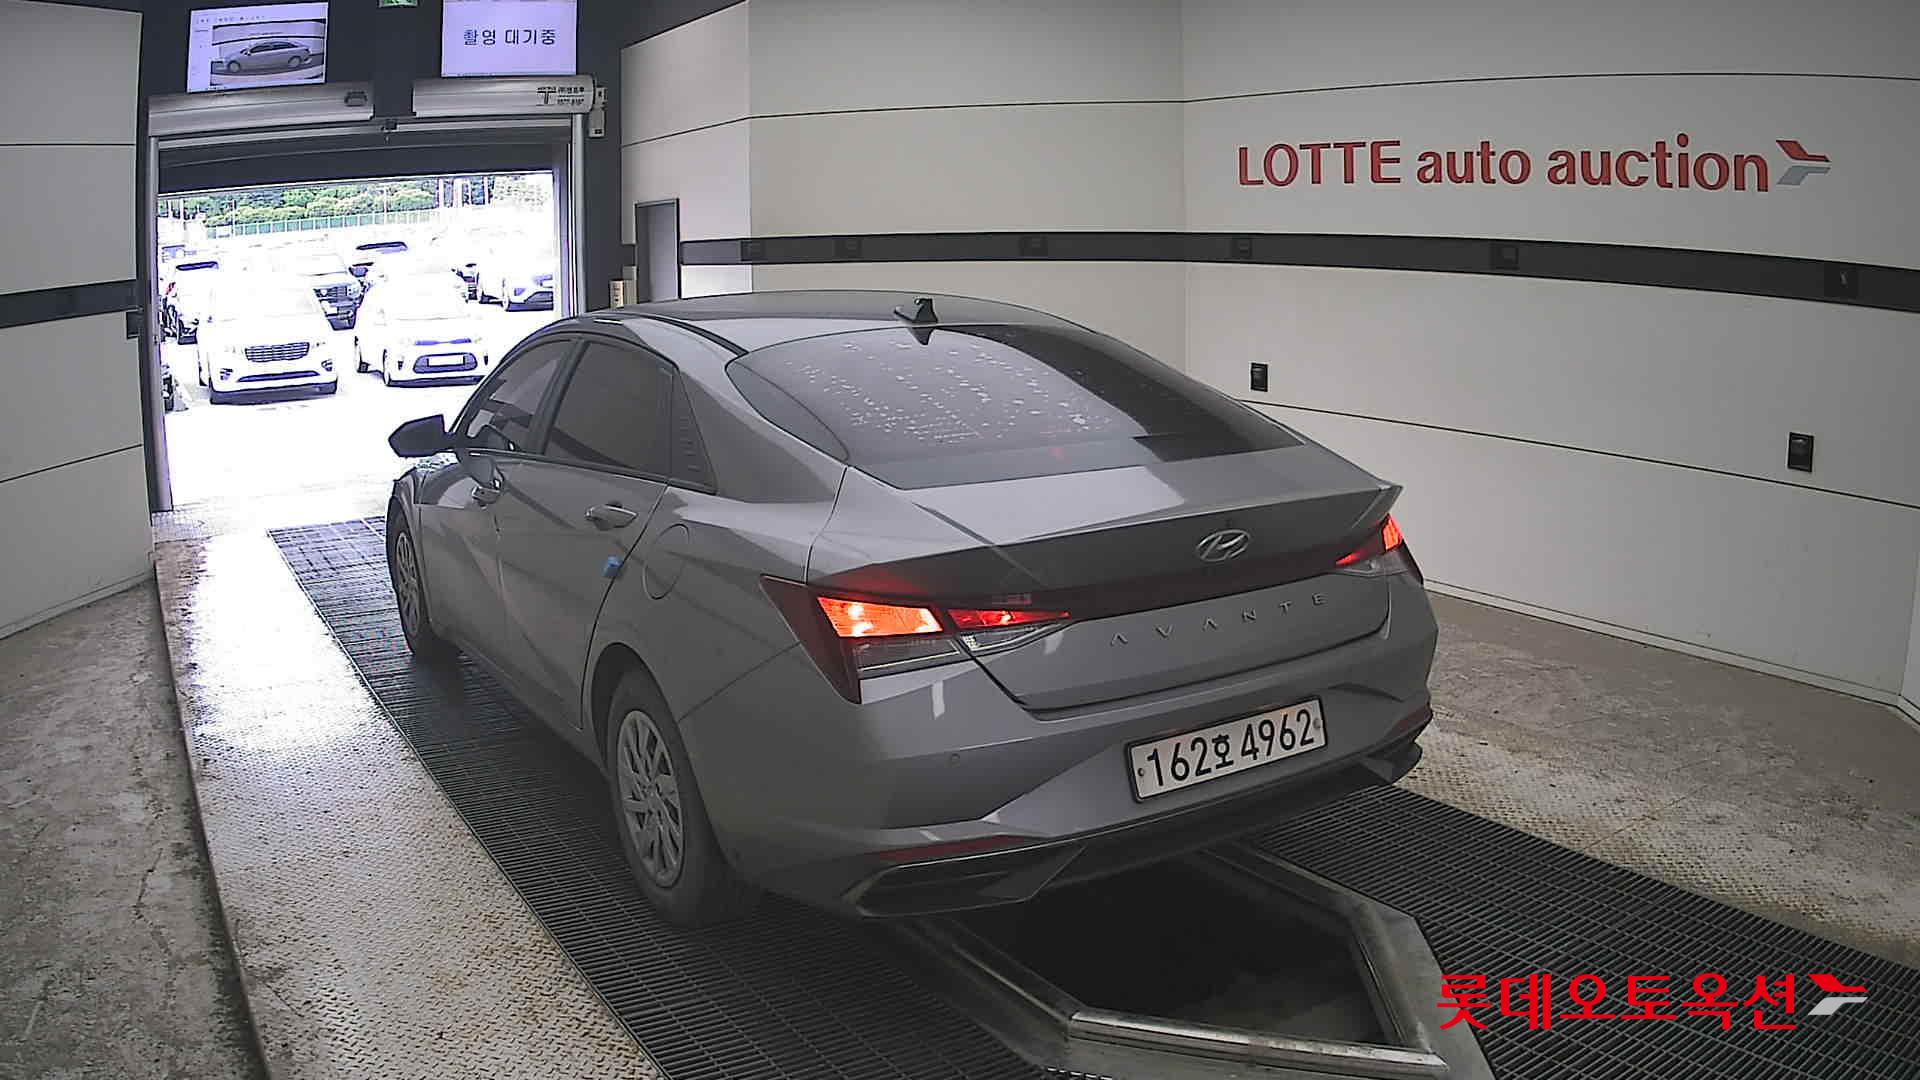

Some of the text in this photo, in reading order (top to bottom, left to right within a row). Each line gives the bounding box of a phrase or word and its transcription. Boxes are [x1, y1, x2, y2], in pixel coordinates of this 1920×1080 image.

[504, 28, 556, 46] 대기중
[1238, 133, 1769, 192] LOTTE auto auction
[1110, 592, 1327, 647] AVANTE
